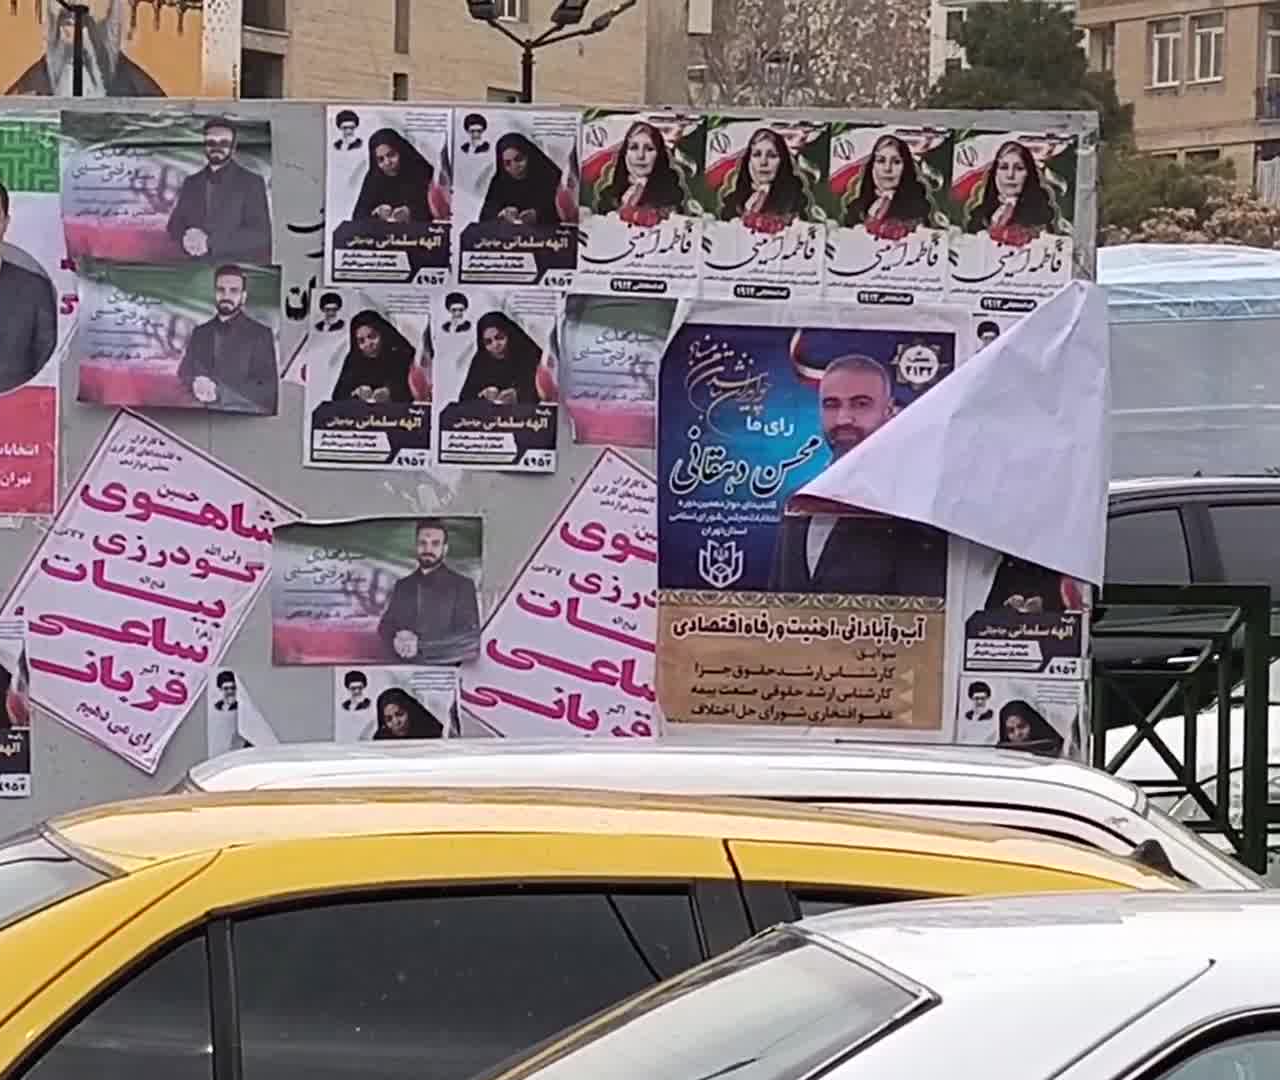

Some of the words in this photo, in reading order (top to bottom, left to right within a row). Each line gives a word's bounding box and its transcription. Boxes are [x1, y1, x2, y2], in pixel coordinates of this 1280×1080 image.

[746, 416, 762, 431] ما
[762, 417, 794, 436] رای
[669, 424, 750, 496] دهستانی
[750, 435, 823, 498] محسن
[80, 482, 272, 545] شاهوی
[93, 532, 265, 585] گودرزی
[40, 555, 226, 629] بیات
[569, 573, 657, 610] درزی
[516, 588, 656, 654] ات
[672, 611, 743, 638] اقتصادی
[744, 611, 774, 640] رفاه
[786, 616, 836, 642] امنیت
[841, 614, 892, 645] آبادانی
[899, 614, 926, 646] آب
[775, 622, 785, 641] و
[889, 625, 900, 643] و
[694, 661, 732, 678] جزا
[732, 664, 776, 679] حقوق
[823, 665, 895, 683] کارشناس
[30, 650, 189, 712] قربان
[804, 687, 836, 702] ارشد
[836, 687, 894, 703] کارشناس
[76, 702, 110, 722] دهیم
[691, 703, 735, 715] اختلاف
[735, 704, 757, 719] حل
[758, 704, 807, 722] شورای
[807, 706, 857, 722] افتخاری
[107, 721, 129, 735] می
[128, 732, 153, 753] رای
